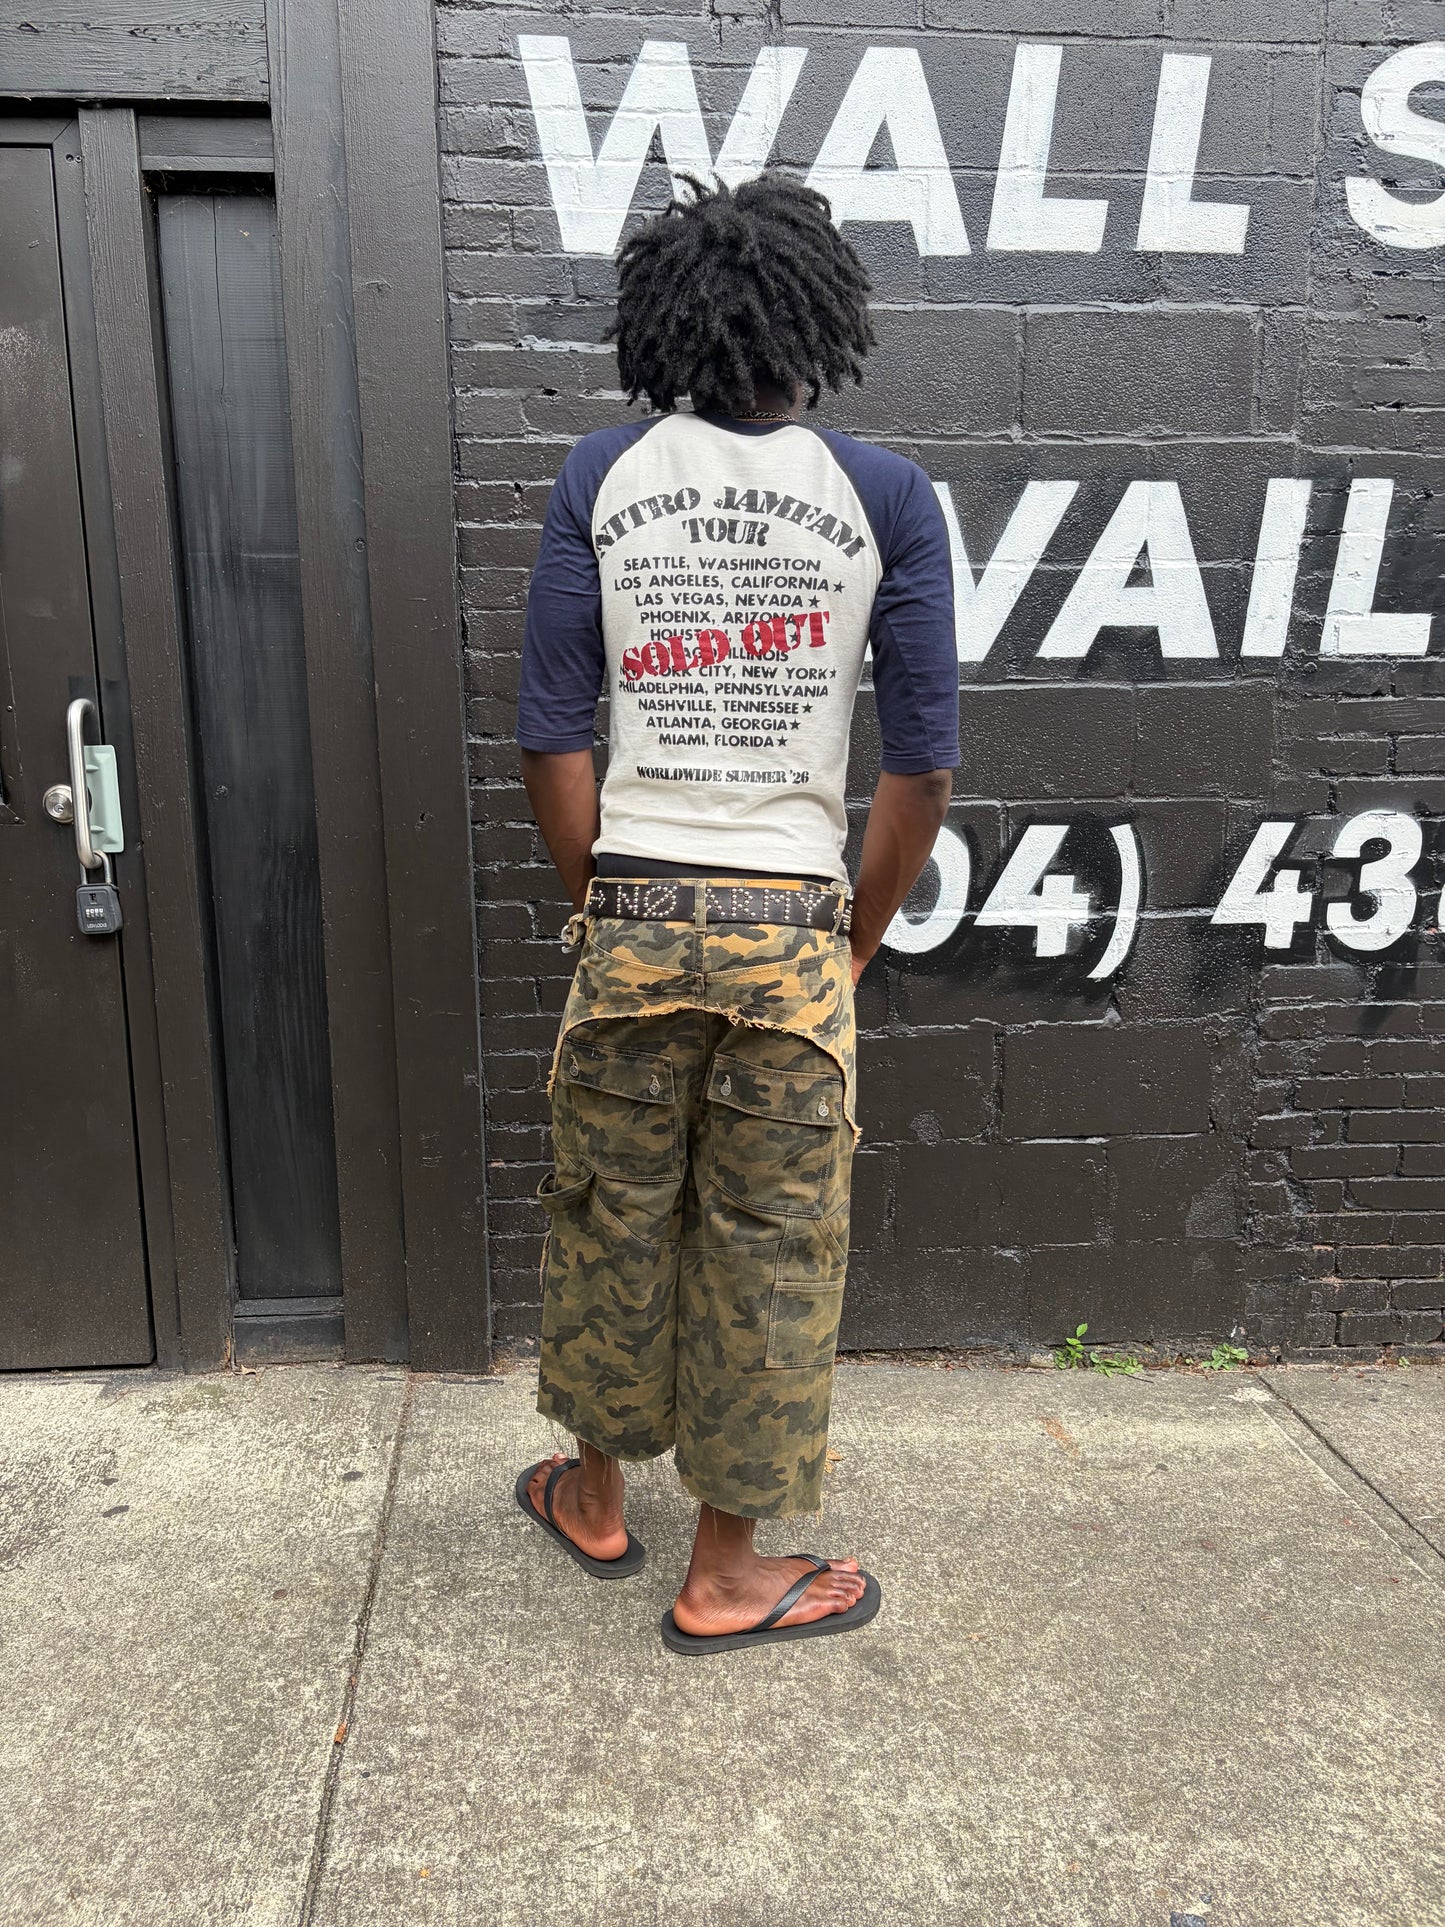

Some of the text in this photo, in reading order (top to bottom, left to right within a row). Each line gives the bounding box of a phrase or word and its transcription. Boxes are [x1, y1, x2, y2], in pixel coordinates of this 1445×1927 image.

[517, 35, 1251, 256] WALL
[596, 487, 701, 559] NITRO
[681, 517, 770, 547] TOUR
[623, 556, 821, 573] SEATTLE, WASHINGTON
[864, 478, 1432, 664] VAIL
[614, 574, 830, 592] LOS ANGELES, CALIFORNIA
[635, 592, 804, 608] LAS VEGAS, NEVADA
[640, 610, 716, 625] PHOENIX,
[622, 611, 830, 682] SOLD OUT
[699, 665, 736, 680] CITY,
[742, 665, 778, 679] NEW
[786, 667, 828, 680] YORK
[619, 680, 828, 697] PHILADELPHIA, PENNSYLVANIA
[638, 700, 799, 715] NASHVILLE, TENNESSEE
[646, 717, 787, 731] ATLANTA, GEORGIA
[659, 734, 774, 748] MIAMI, FLORIDA
[636, 766, 810, 785] WORLDWIDE SUMMER '26
[1210, 810, 1445, 952] 43
